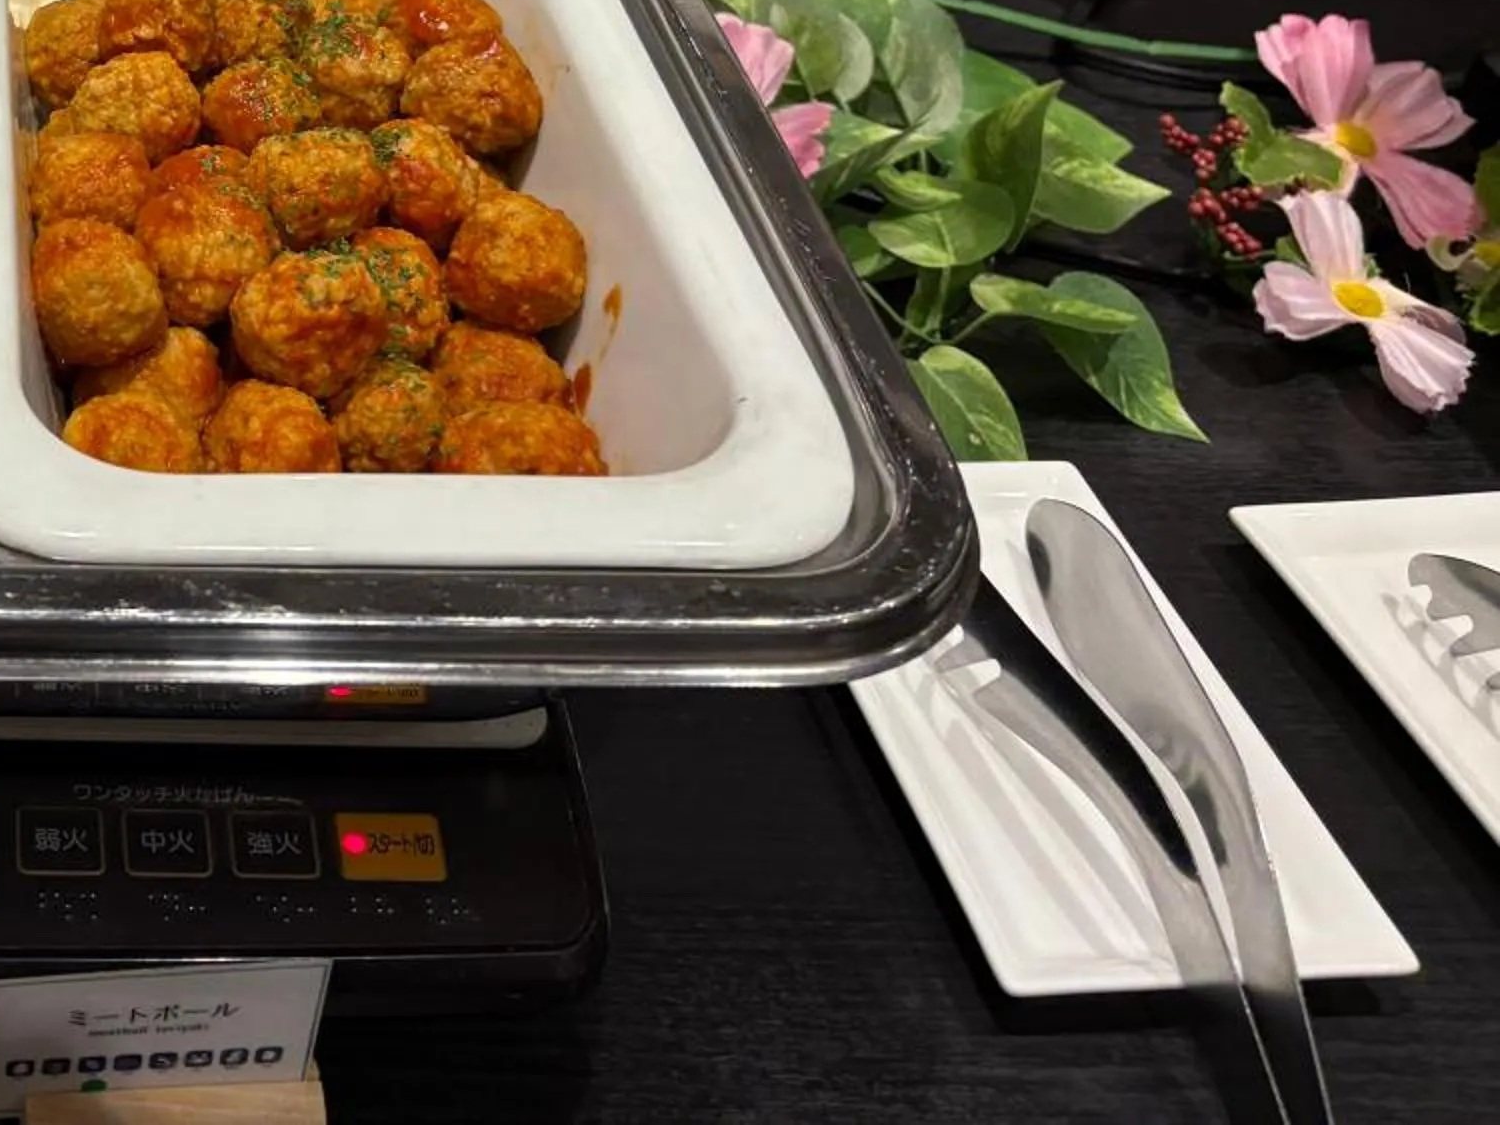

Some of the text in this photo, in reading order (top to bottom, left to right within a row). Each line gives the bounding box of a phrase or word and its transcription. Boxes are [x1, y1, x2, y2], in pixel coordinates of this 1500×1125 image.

[34, 827, 89, 855] 弱火
[140, 829, 195, 856] 中火
[246, 829, 301, 857] 強火
[68, 1002, 240, 1026] ミートボール
